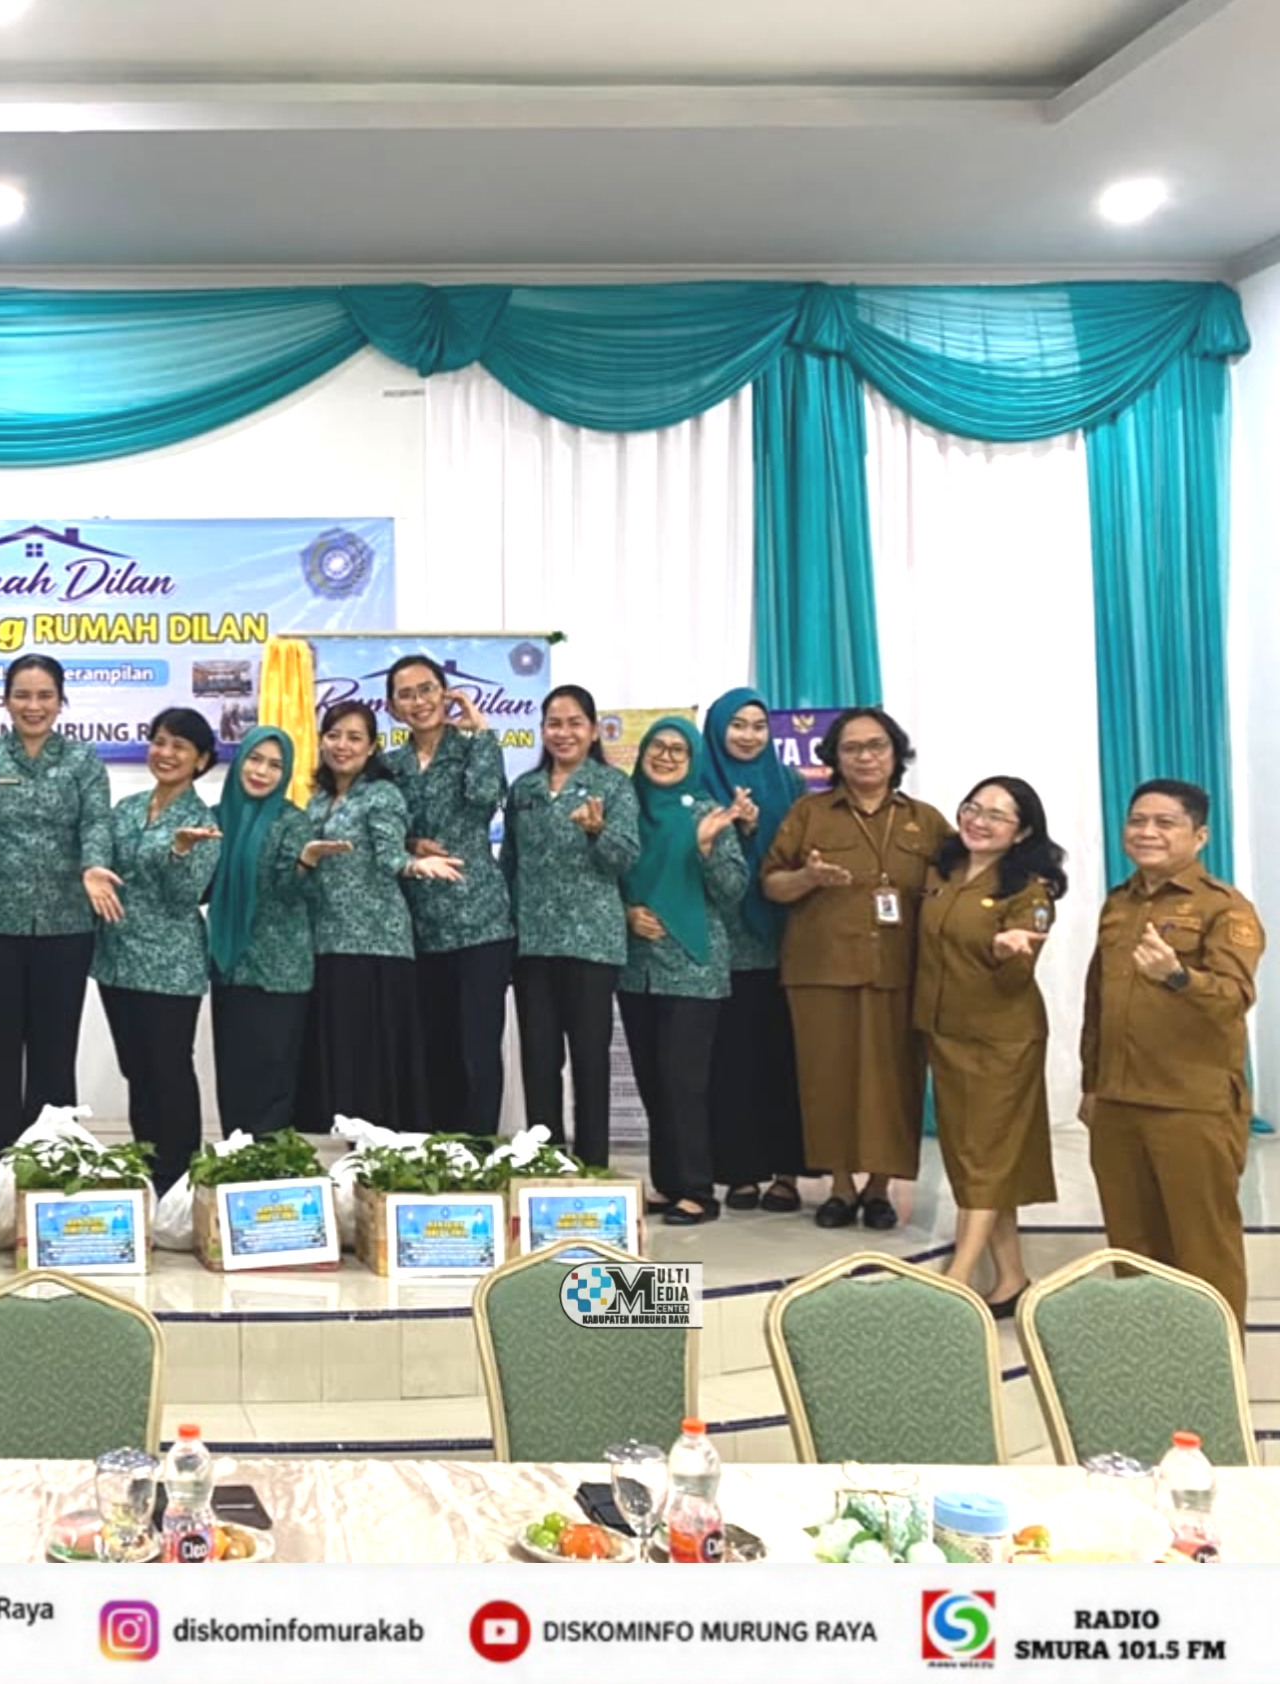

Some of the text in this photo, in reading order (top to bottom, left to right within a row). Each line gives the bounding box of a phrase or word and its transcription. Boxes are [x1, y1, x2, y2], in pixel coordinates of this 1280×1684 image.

[58, 557, 175, 602] Dilan
[33, 613, 159, 644] RUMAH
[167, 613, 268, 644] DILAN
[63, 663, 154, 686] erampilan
[181, 1541, 208, 1560] Cleo
